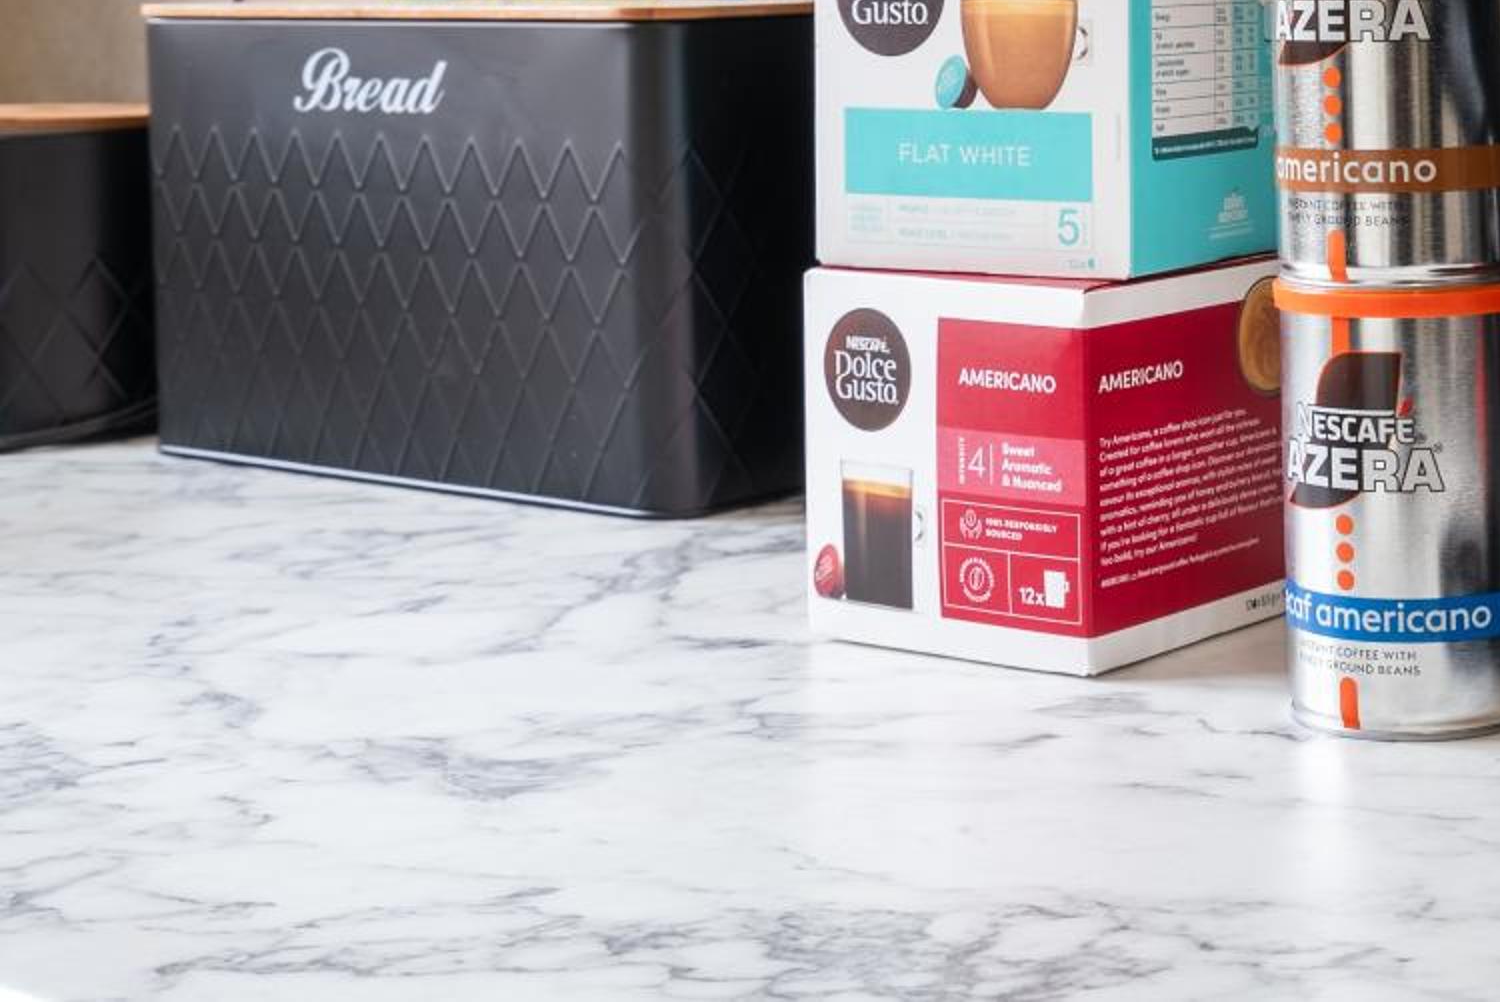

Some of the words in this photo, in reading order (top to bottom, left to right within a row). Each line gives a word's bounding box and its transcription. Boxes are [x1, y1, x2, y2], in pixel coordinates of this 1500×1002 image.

[293, 47, 447, 114] Bread
[898, 143, 952, 164] FLAT
[960, 147, 1031, 167] WHITE
[1057, 208, 1081, 247] 5
[834, 350, 897, 381] Dolce
[1098, 360, 1184, 394] AMERICANO
[836, 377, 898, 404] Gusto
[959, 368, 1057, 394] AMERICANO
[1002, 442, 1035, 457] Sweet
[968, 447, 986, 479] 4
[1002, 459, 1053, 475] Aromatic
[1288, 438, 1445, 493] AZERA
[1012, 476, 1063, 493] Nuanced
[1019, 586, 1045, 606] 12x
[1316, 601, 1492, 634] americano
[1383, 650, 1417, 662] WITH
[1378, 665, 1421, 677] BEANS
